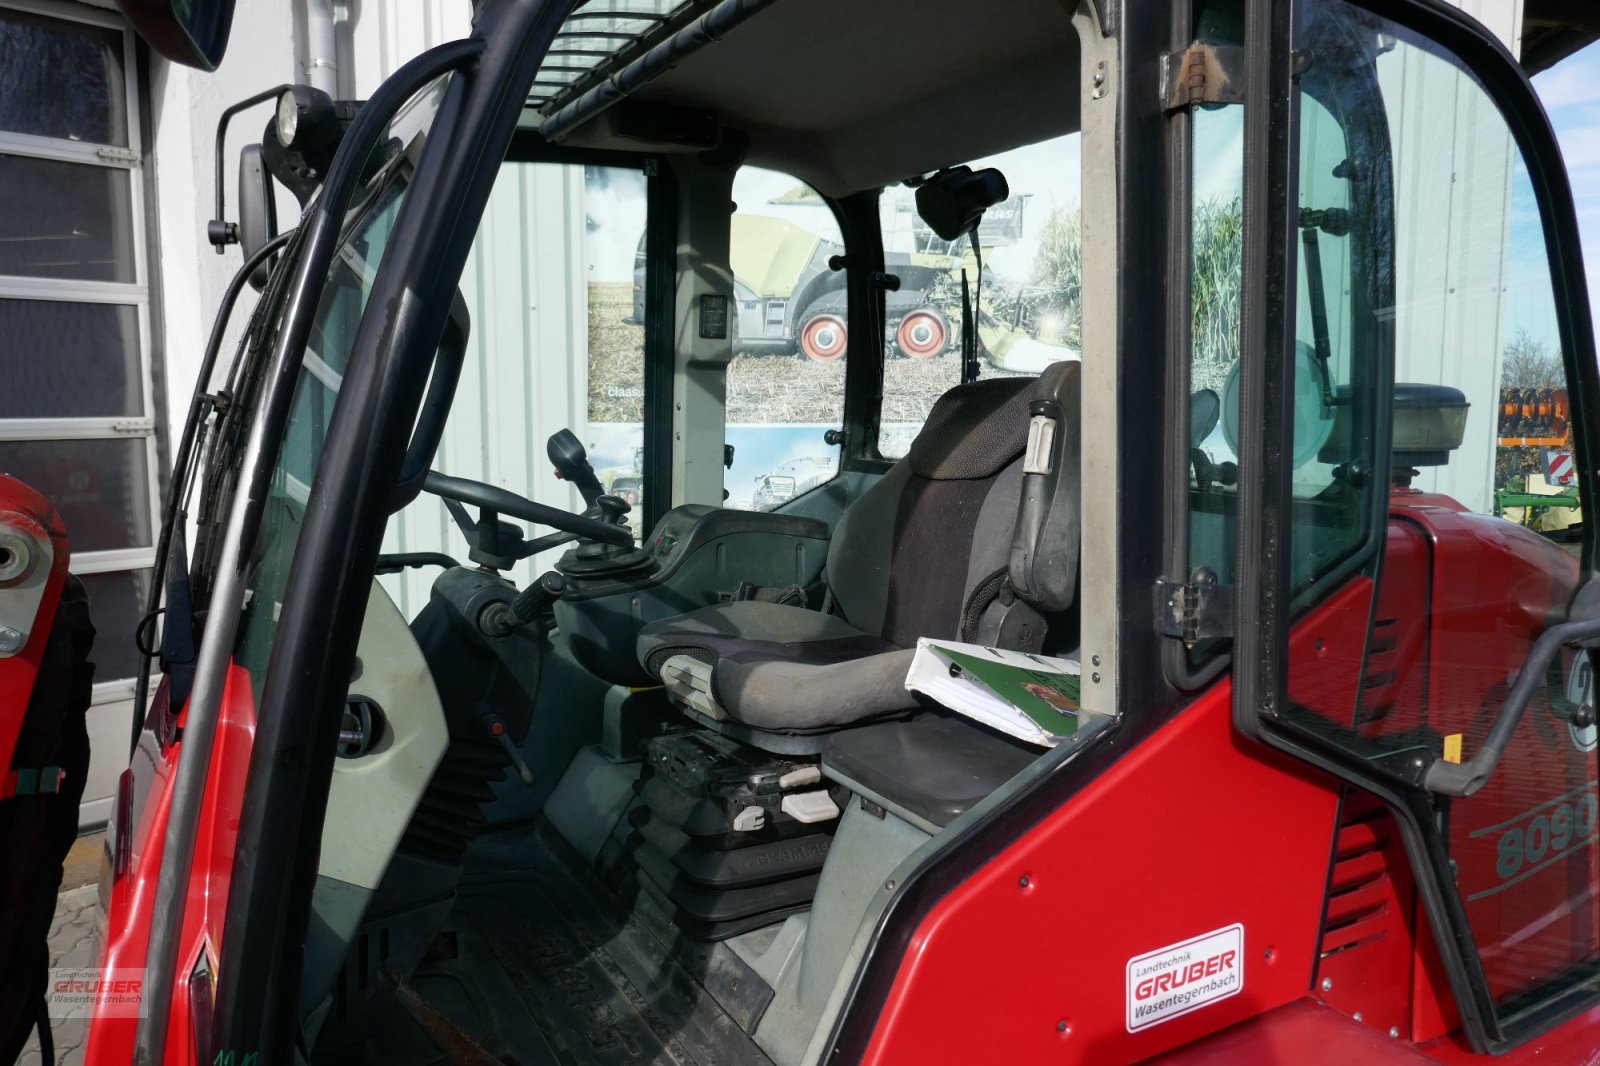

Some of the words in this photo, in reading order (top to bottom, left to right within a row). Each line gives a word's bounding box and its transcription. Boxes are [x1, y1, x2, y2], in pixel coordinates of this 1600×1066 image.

[1496, 793, 1597, 877] 8090
[1135, 950, 1235, 1001] GRUBER
[1136, 951, 1191, 977] Landtechnik
[1135, 973, 1235, 1018] Wasentegernbach
